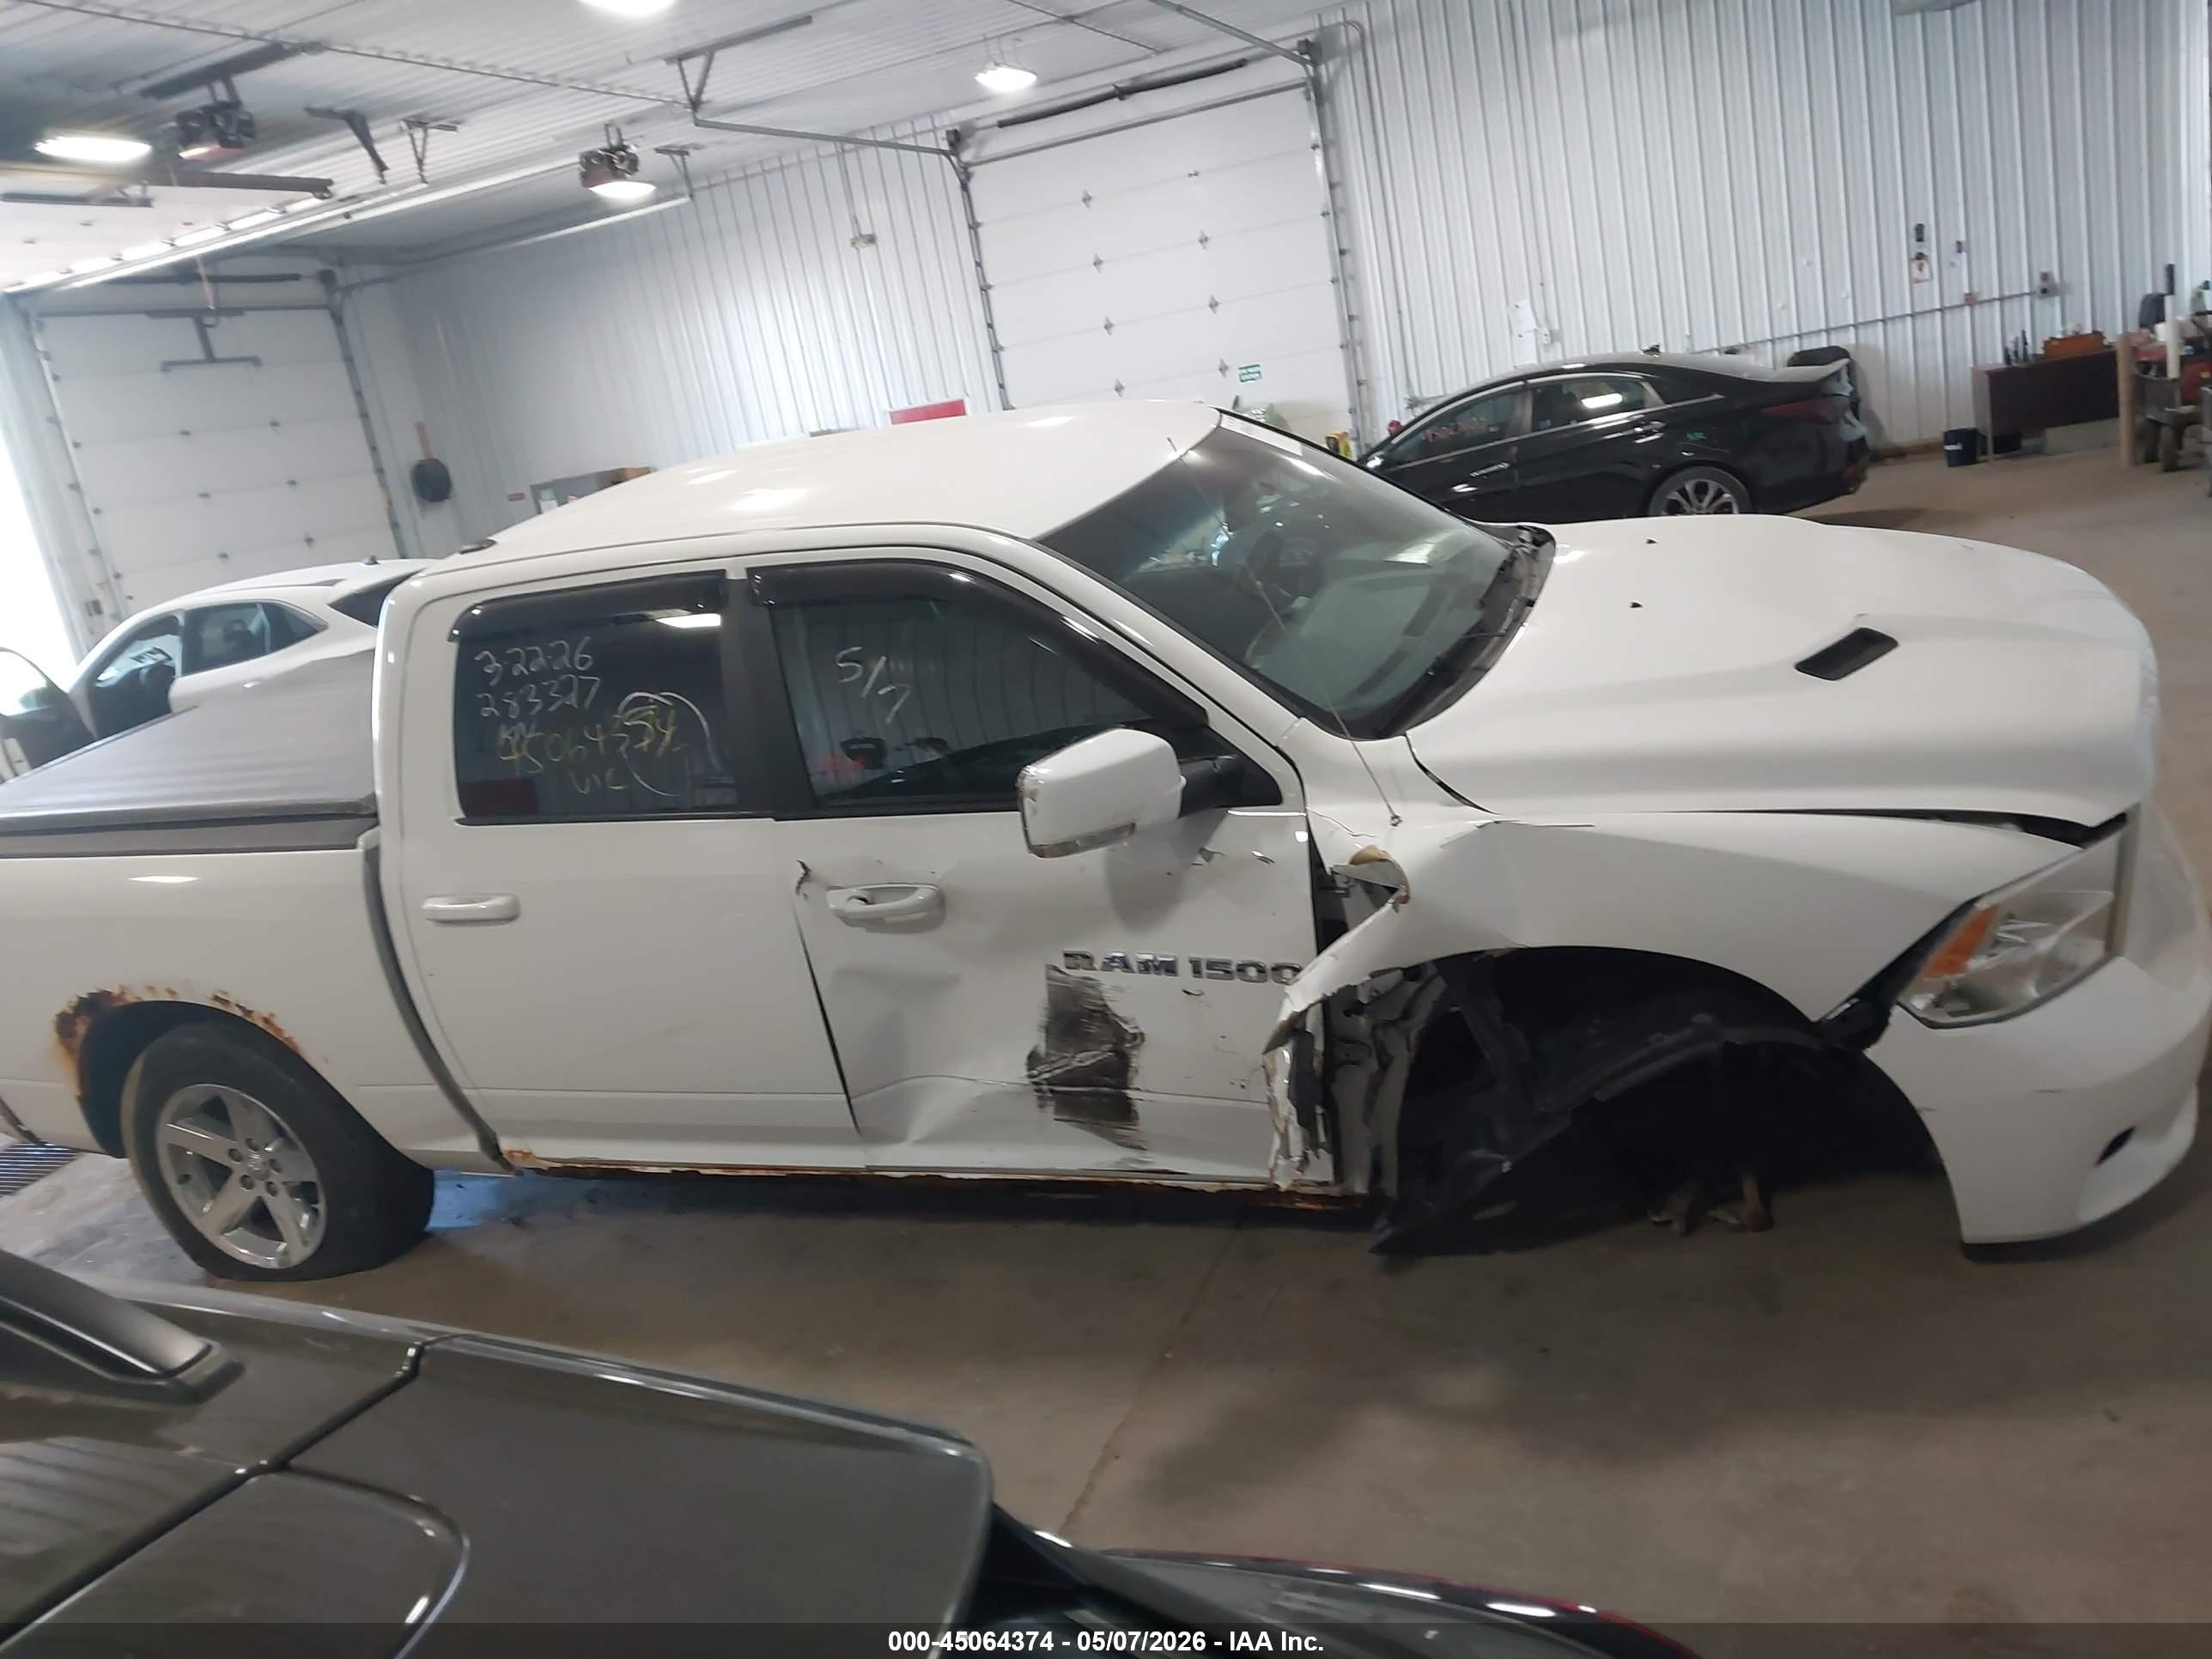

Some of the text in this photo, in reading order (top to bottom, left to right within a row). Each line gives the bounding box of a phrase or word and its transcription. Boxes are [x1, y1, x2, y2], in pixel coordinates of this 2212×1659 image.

[836, 646, 911, 725] 5/7
[1062, 951, 1304, 986] RAM 1500
